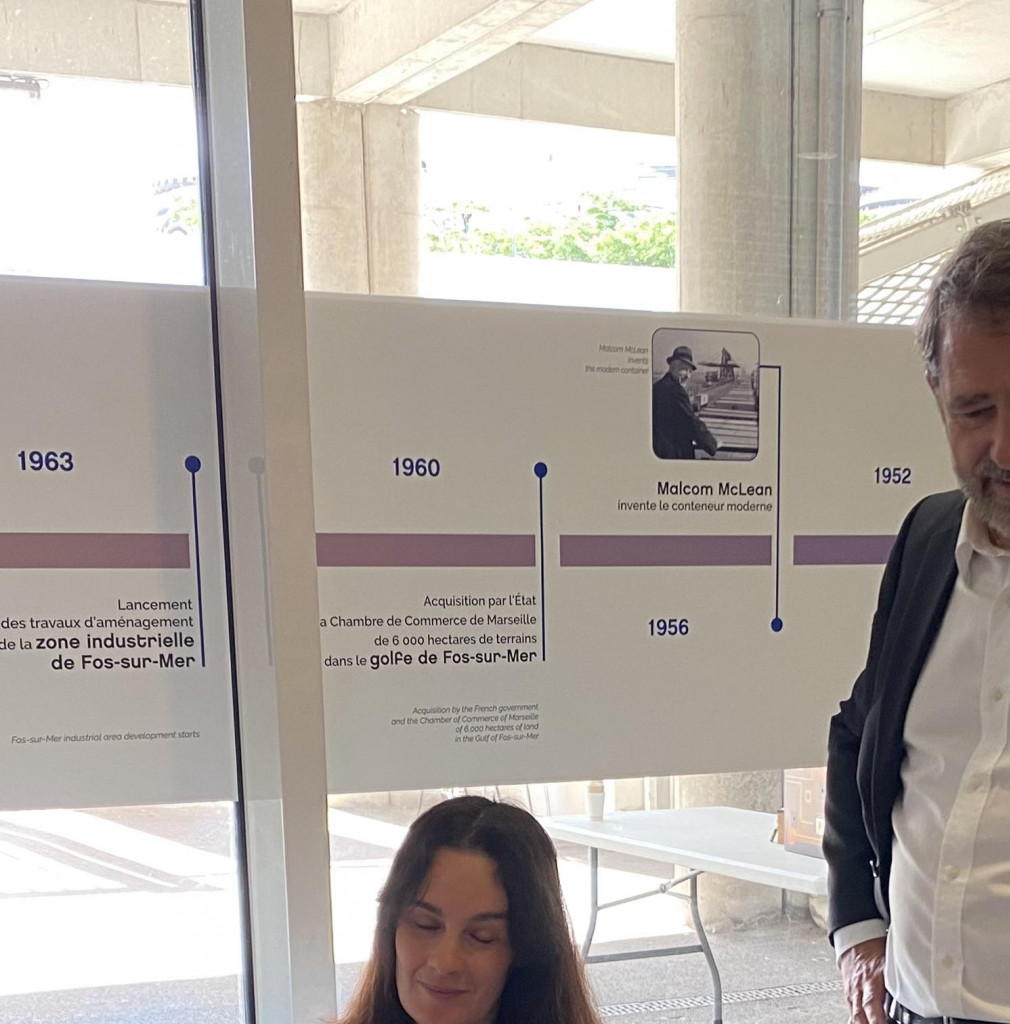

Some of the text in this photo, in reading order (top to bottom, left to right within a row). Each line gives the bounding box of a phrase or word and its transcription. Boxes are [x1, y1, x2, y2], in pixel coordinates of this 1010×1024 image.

[17, 450, 75, 472] 1963
[392, 457, 441, 477] 1960
[873, 467, 912, 485] 1952
[657, 481, 773, 497] Malcom McLean
[617, 499, 773, 513] invente le conteneur moderne
[117, 599, 194, 612] Lancement
[423, 592, 537, 610] Acquisition par l'État
[1, 616, 194, 632] des travaux d'aménagement
[330, 615, 384, 628] Chambre
[386, 615, 402, 627] de
[404, 615, 467, 627] Commerce
[469, 614, 485, 626] de
[487, 613, 537, 626] Marseille
[648, 618, 690, 637] 1956
[0, 632, 195, 652] de la zone industrielle
[374, 632, 537, 647] de 6 000 hectares de terrains
[51, 653, 196, 671] de Fos-sur-Mer
[324, 648, 538, 671] dans le golfe de Fos-sur-Mer
[412, 706, 450, 716] Acquisition
[451, 706, 461, 716] by
[461, 705, 473, 714] the
[474, 704, 497, 713] French
[390, 717, 406, 726] and
[406, 717, 418, 725] the
[419, 716, 452, 725] Chamber
[461, 714, 499, 724] Commerce
[484, 723, 514, 733] hectares
[63, 733, 102, 743] industrial
[103, 733, 122, 742] area
[123, 730, 176, 742] development
[177, 730, 200, 739] starts
